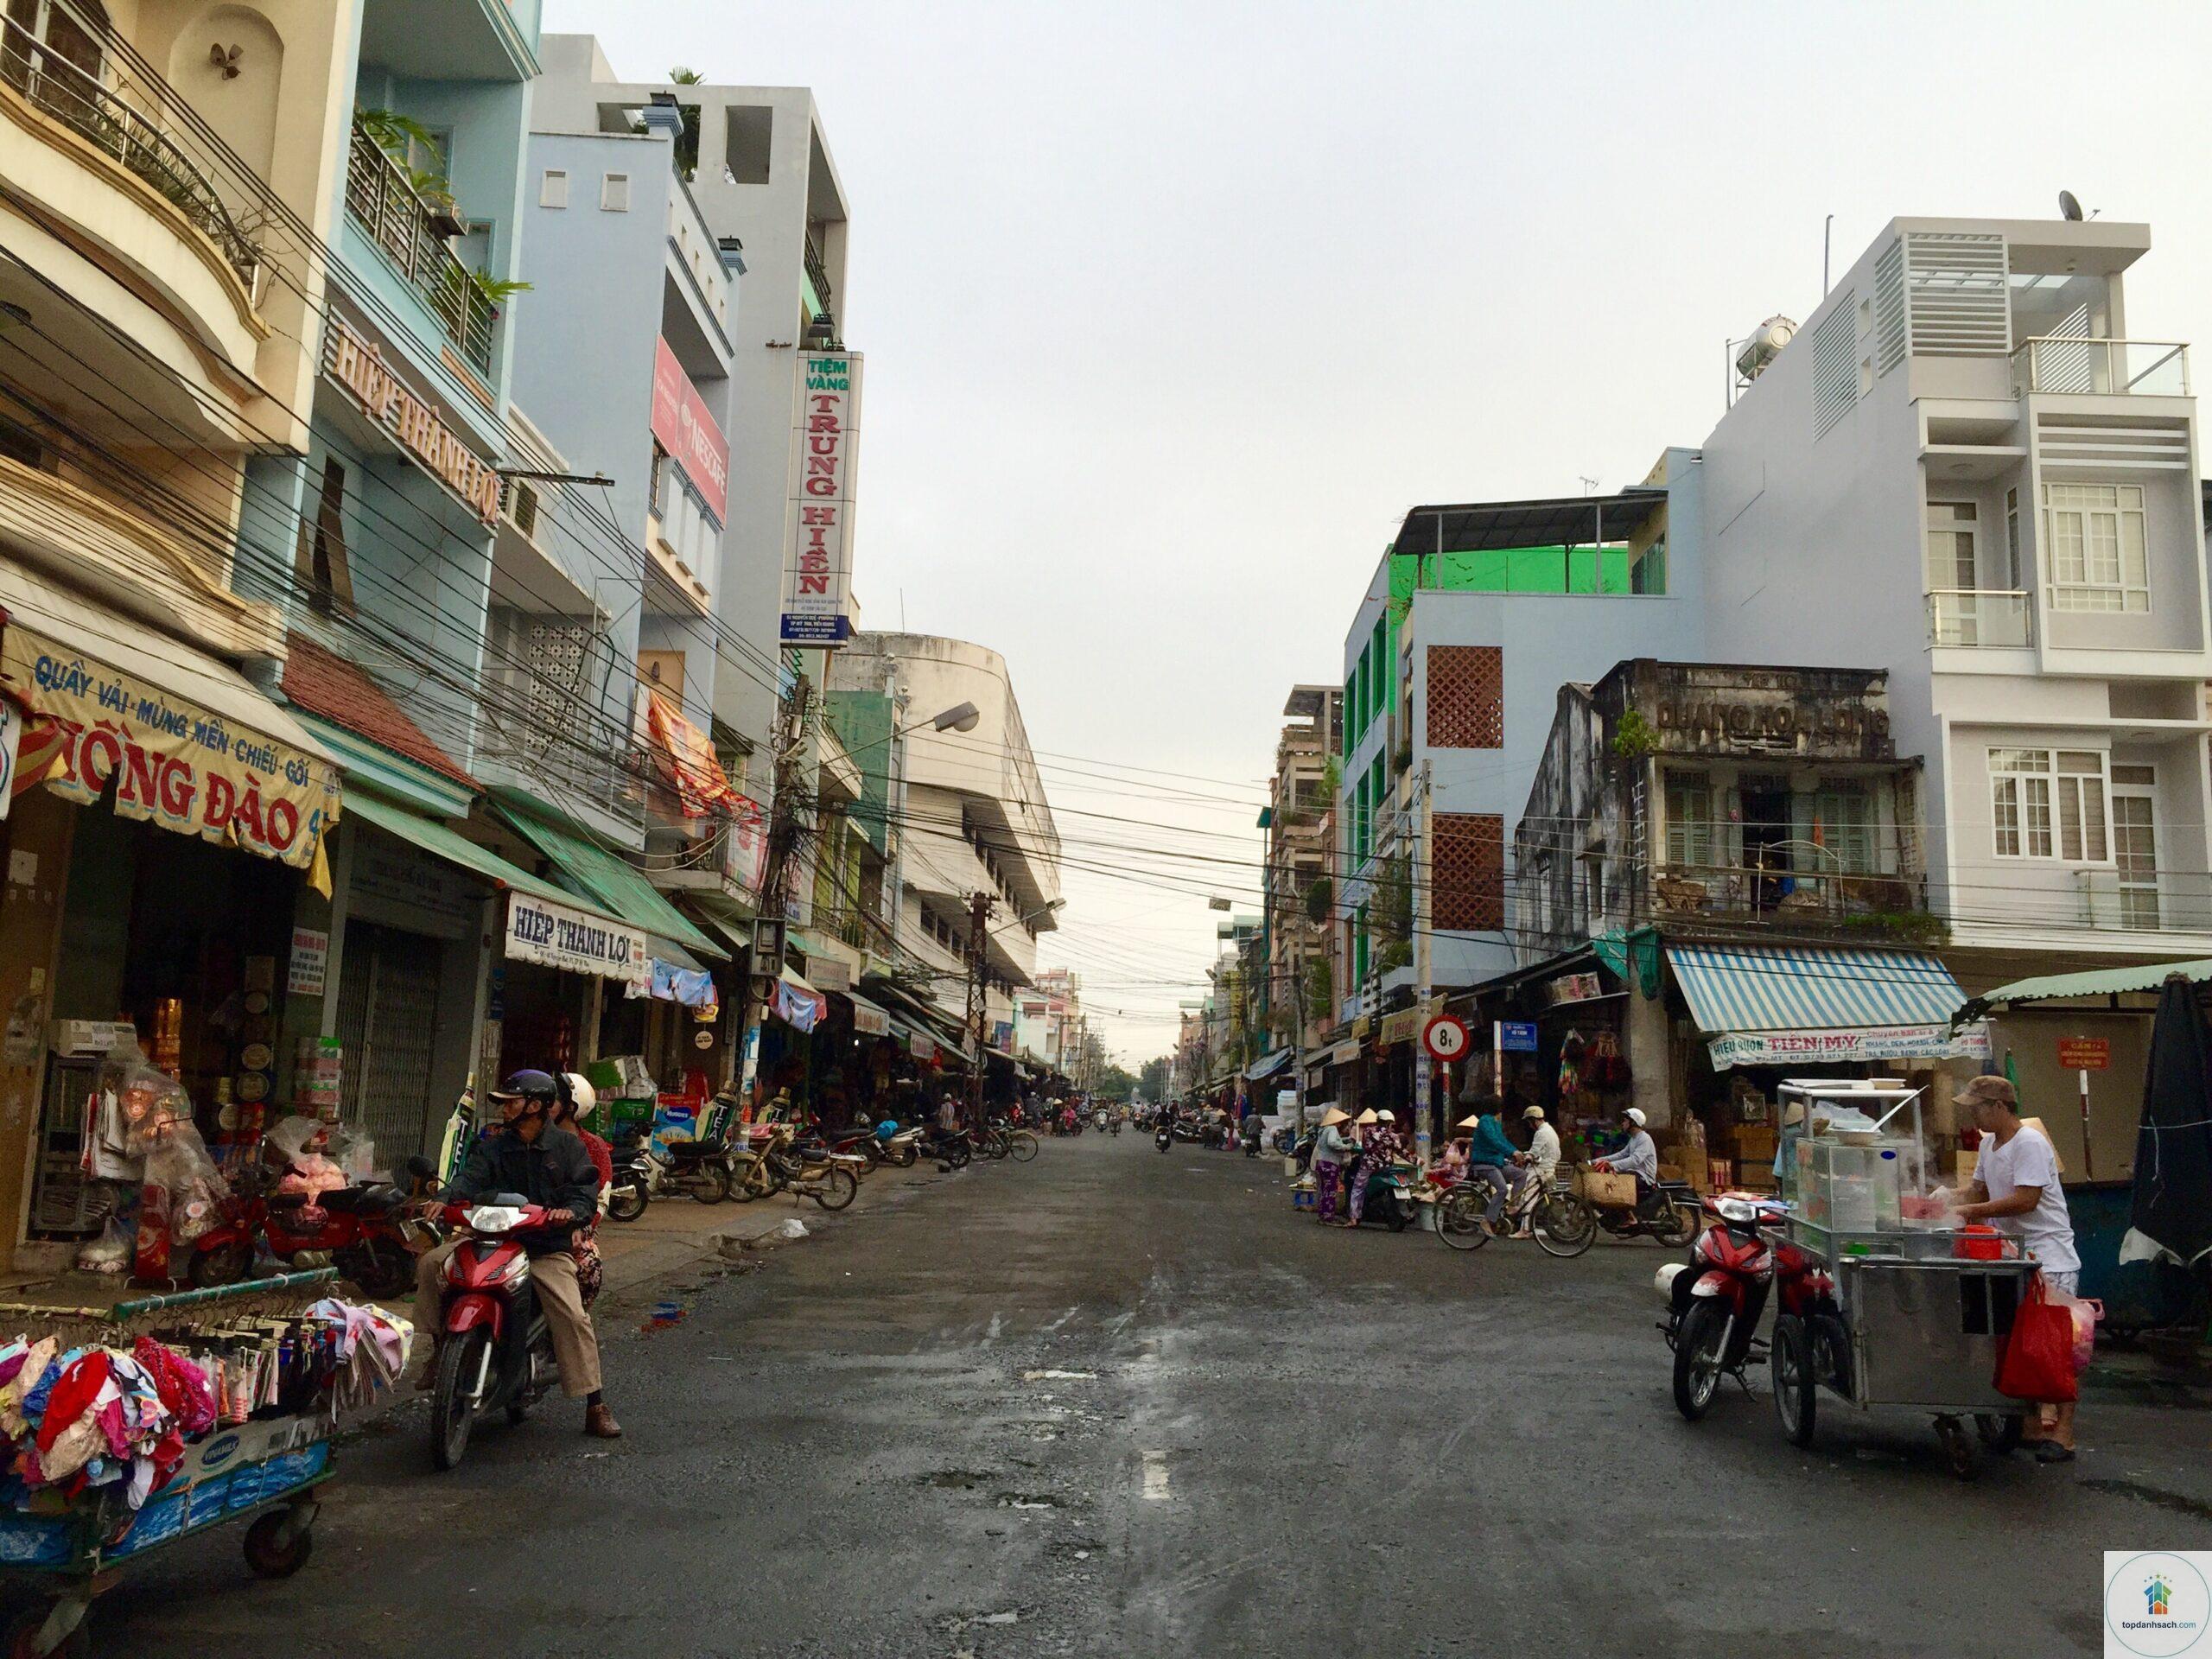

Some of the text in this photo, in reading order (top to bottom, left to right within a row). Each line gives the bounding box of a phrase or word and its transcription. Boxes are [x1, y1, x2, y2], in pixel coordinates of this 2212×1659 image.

[806, 375, 849, 391] VÀNG
[808, 358, 847, 376] TIỆM
[806, 394, 841, 496] TRUNG
[35, 655, 93, 698] QUẦY
[285, 758, 310, 787] GỐI
[203, 771, 298, 850] ĐÀO
[514, 904, 555, 951] HIỆP
[557, 916, 607, 958] THÀNH
[608, 933, 632, 969] LỢI
[709, 1104, 728, 1141] TEA
